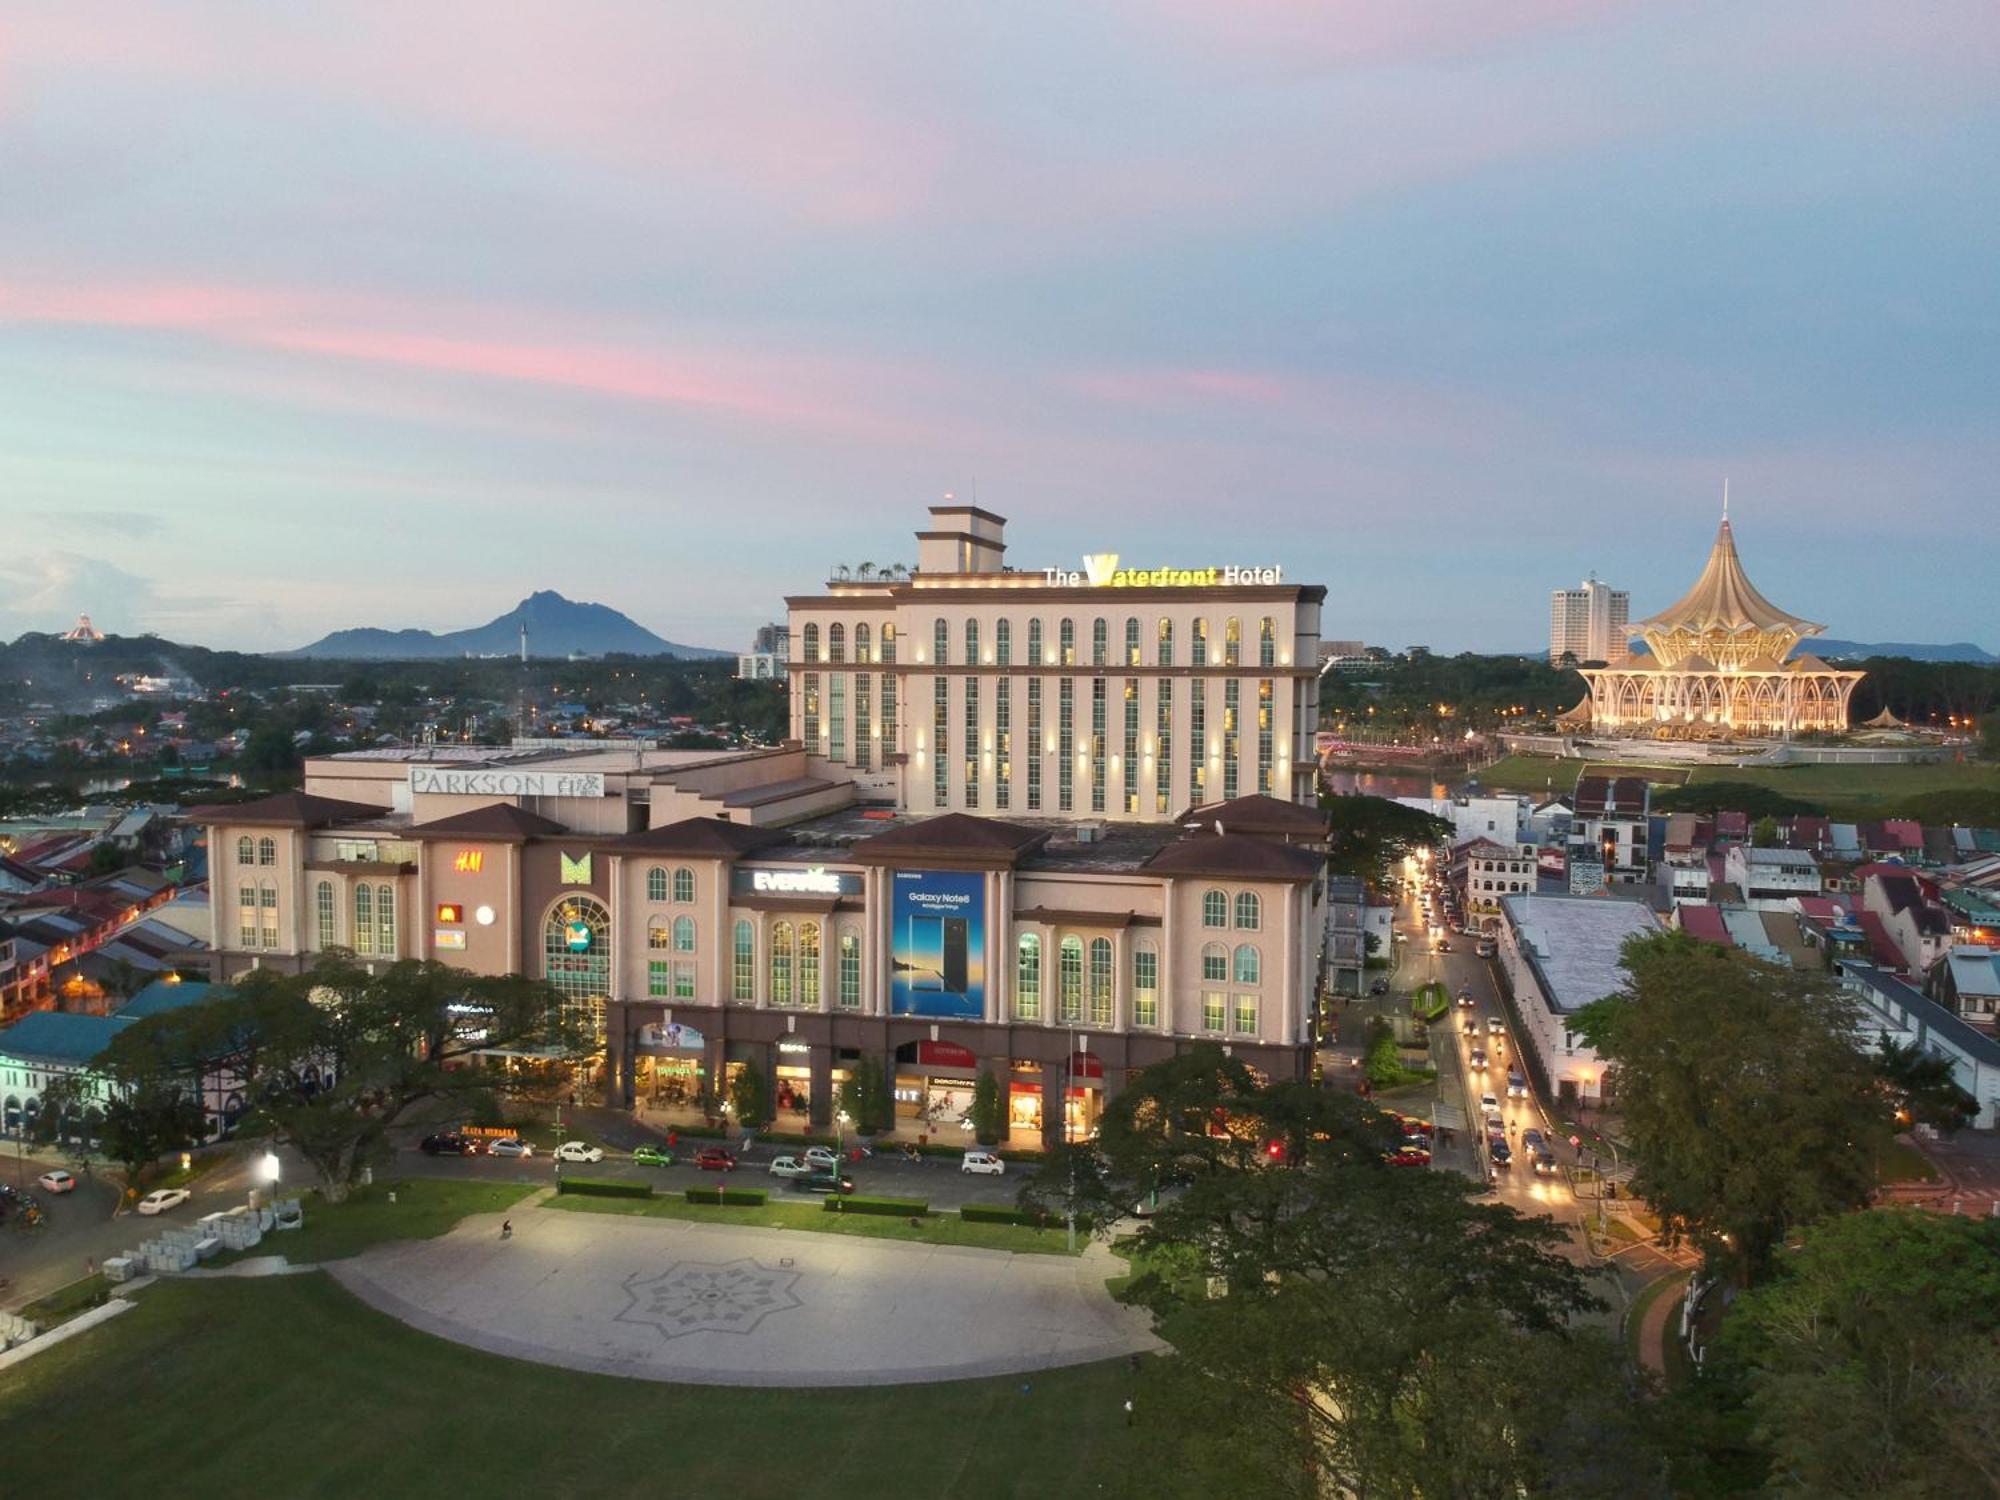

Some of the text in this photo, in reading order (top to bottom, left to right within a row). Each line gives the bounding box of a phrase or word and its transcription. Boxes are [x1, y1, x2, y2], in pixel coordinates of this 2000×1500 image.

[1043, 554, 1282, 587] The Waterfront Hotel
[411, 771, 544, 796] PARKSON
[909, 893, 941, 903] Galaxy
